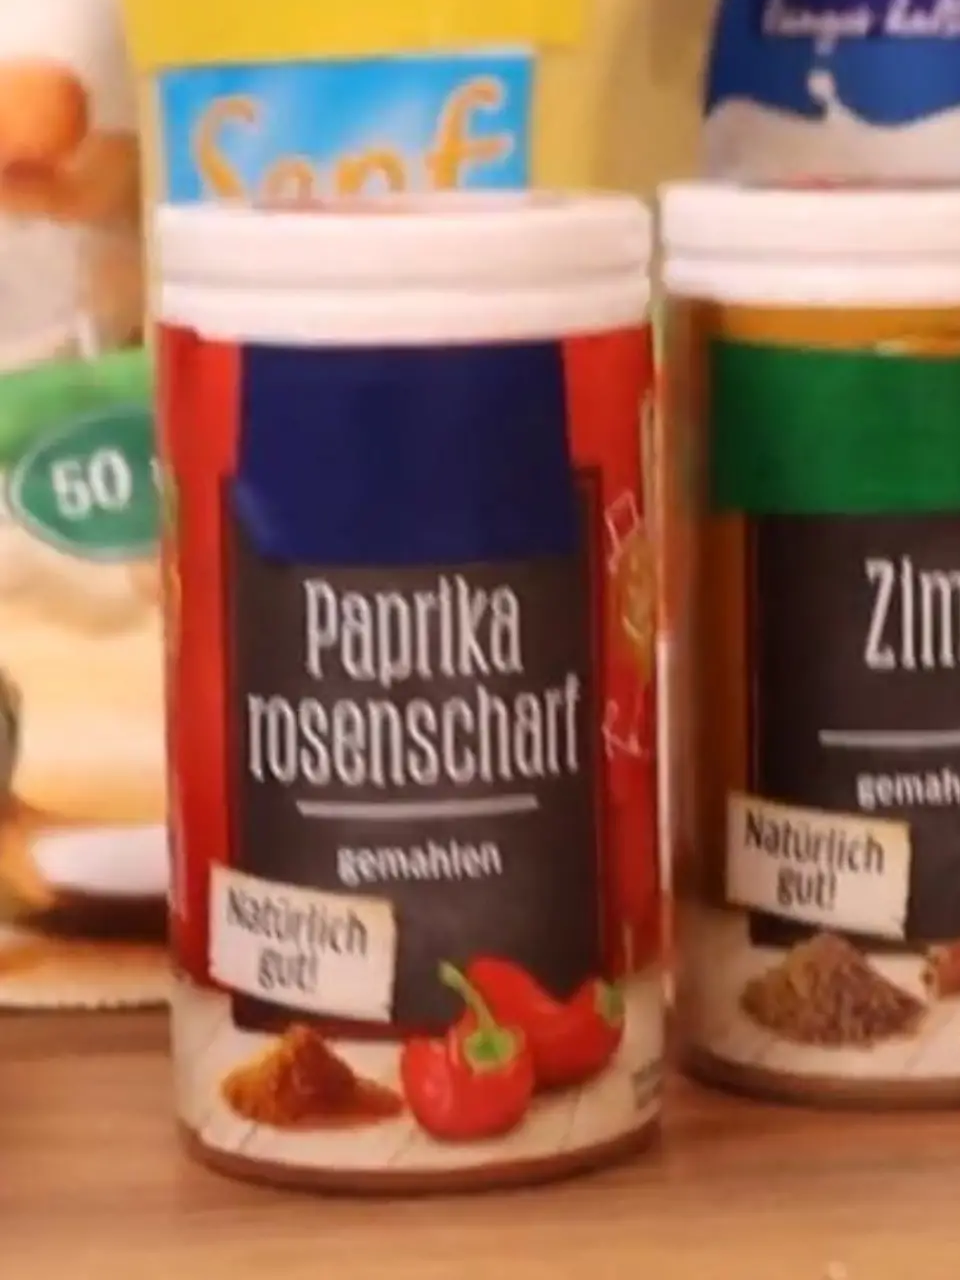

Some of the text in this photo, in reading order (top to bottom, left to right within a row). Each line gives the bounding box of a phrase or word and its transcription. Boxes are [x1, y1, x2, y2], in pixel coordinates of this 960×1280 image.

[302, 572, 525, 689] Paprika
[246, 670, 582, 788] rosenscharf
[336, 837, 503, 888] gemahlen
[775, 867, 838, 912] gut!
